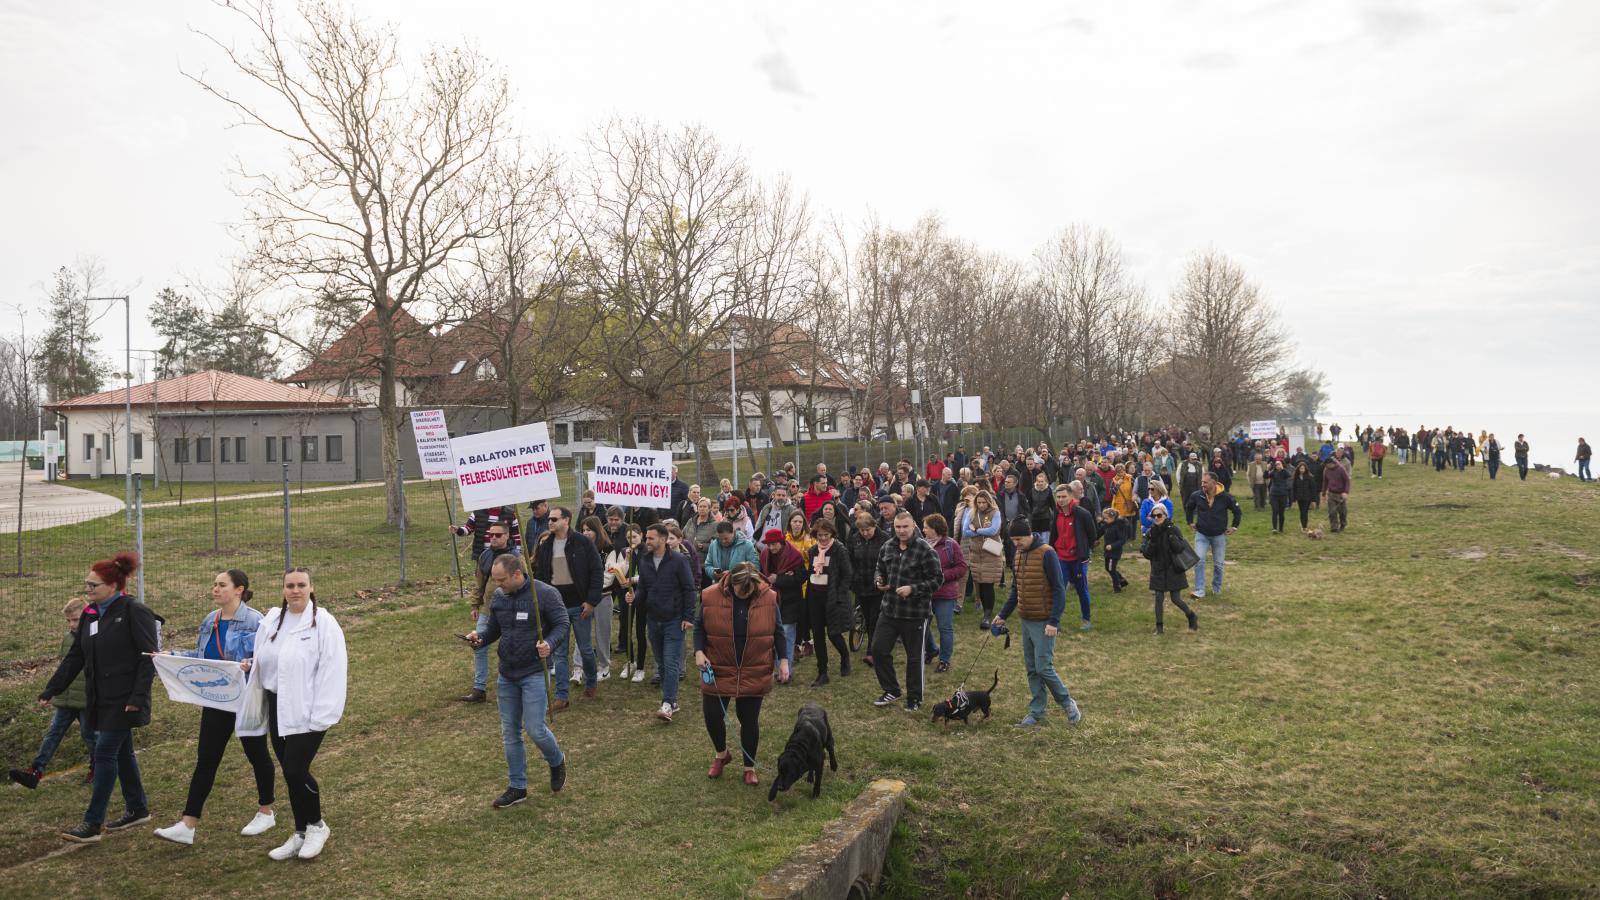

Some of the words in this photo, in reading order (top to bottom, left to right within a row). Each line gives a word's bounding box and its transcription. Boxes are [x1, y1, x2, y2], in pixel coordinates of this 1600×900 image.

[459, 458, 466, 466] A
[469, 449, 516, 464] BALATON
[519, 444, 545, 456] PART
[612, 454, 620, 463] A
[624, 456, 655, 466] PART
[460, 460, 552, 486] FELBECSÜLHETETLEN!
[597, 466, 670, 481] MINDENKIÉ,
[596, 481, 647, 496] MARADJON
[650, 482, 669, 498] ÍGY!
